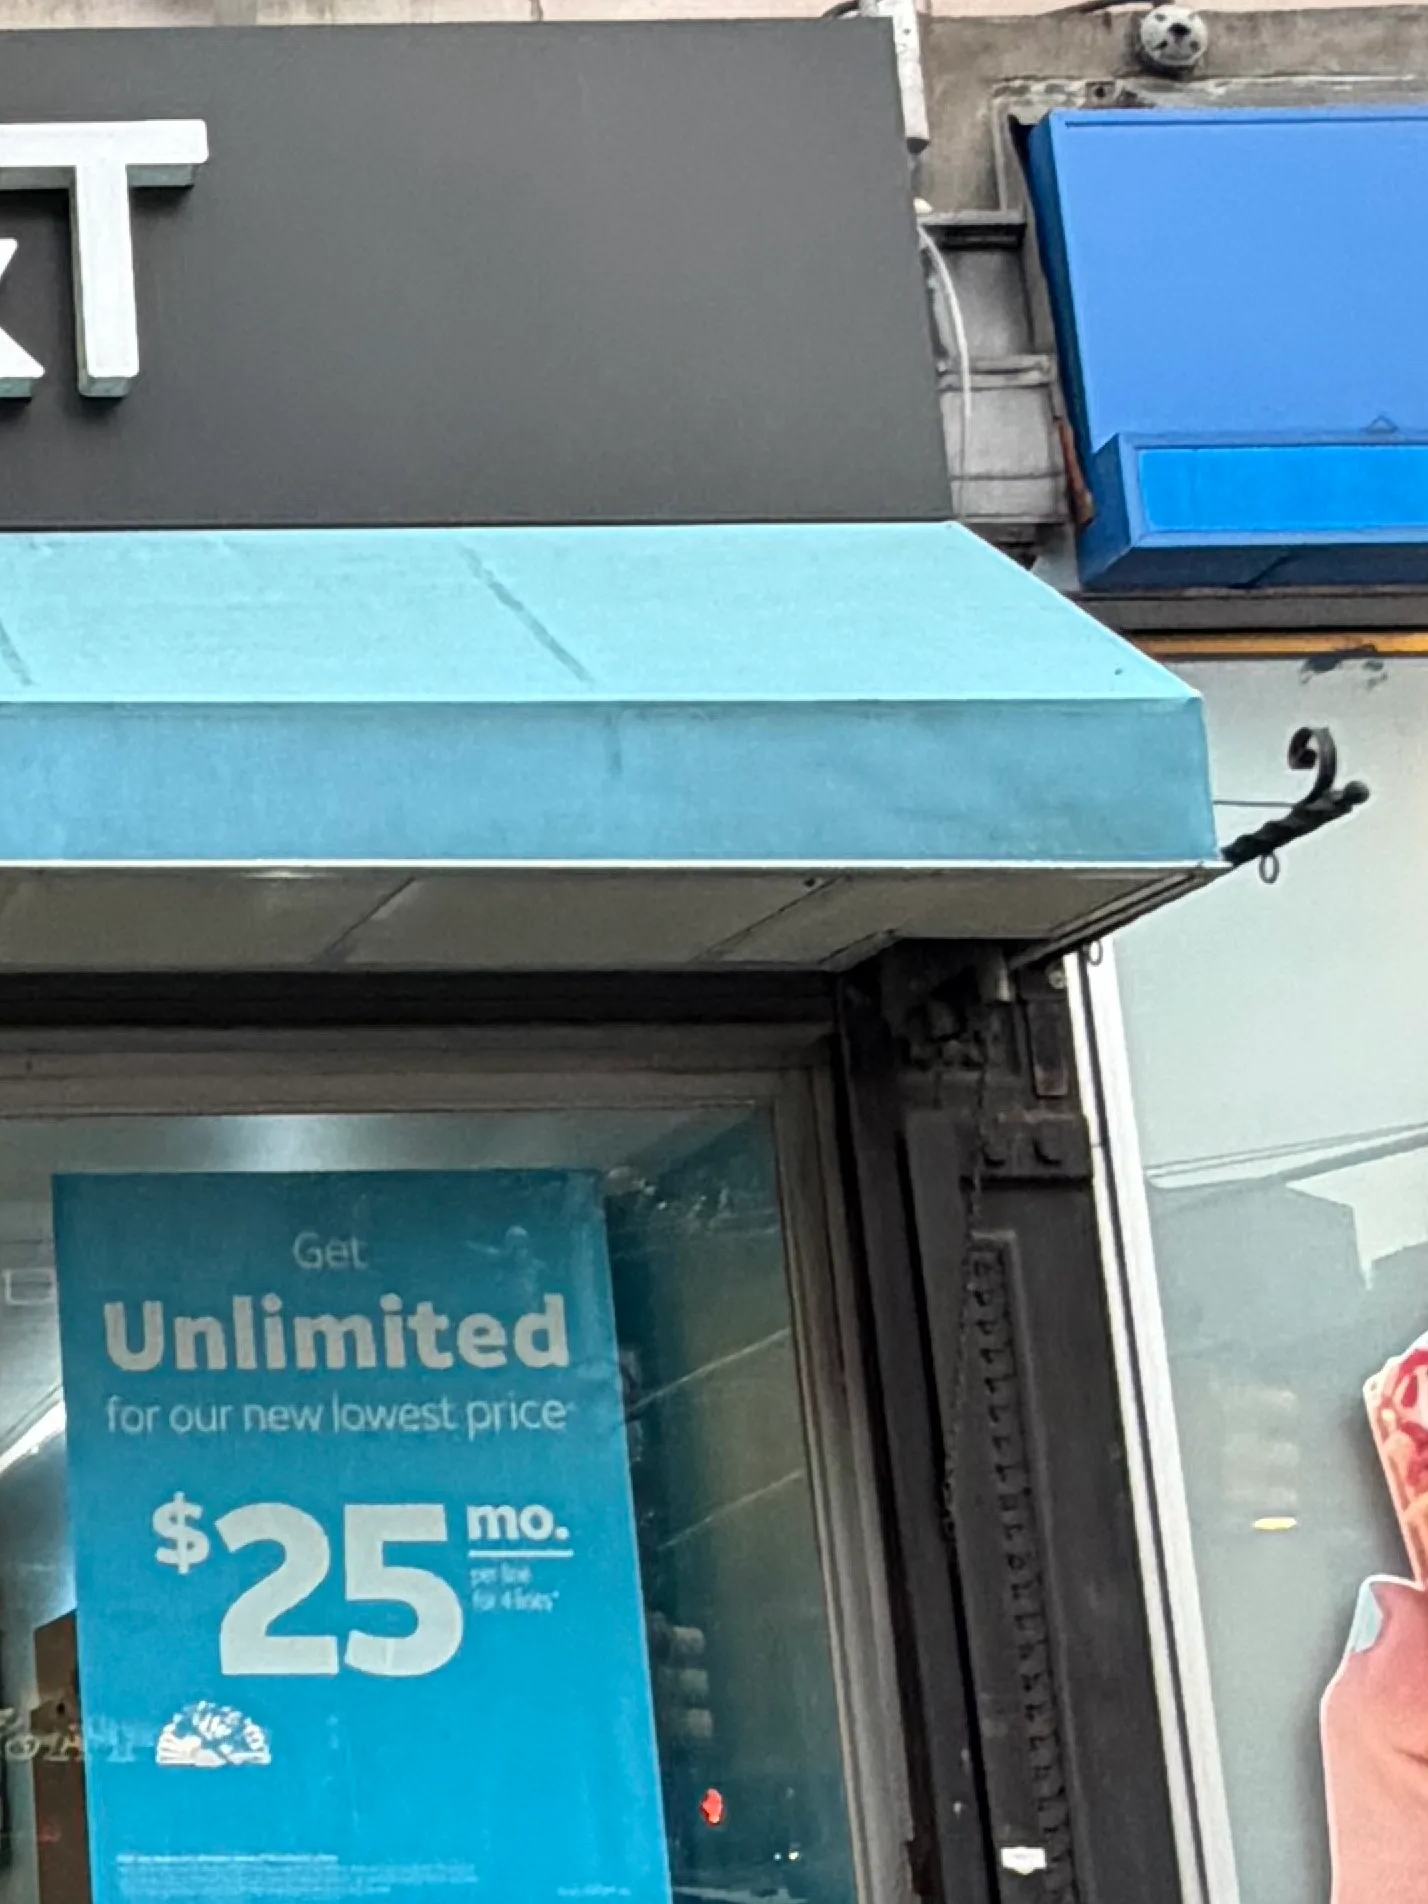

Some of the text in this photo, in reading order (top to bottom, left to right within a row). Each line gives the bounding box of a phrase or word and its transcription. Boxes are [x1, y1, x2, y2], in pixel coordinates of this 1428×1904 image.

[292, 1231, 368, 1270] Get
[103, 1293, 571, 1371] Unlimited
[107, 1394, 567, 1439] for our new lowest price
[152, 1492, 570, 1676] $25 mo.
